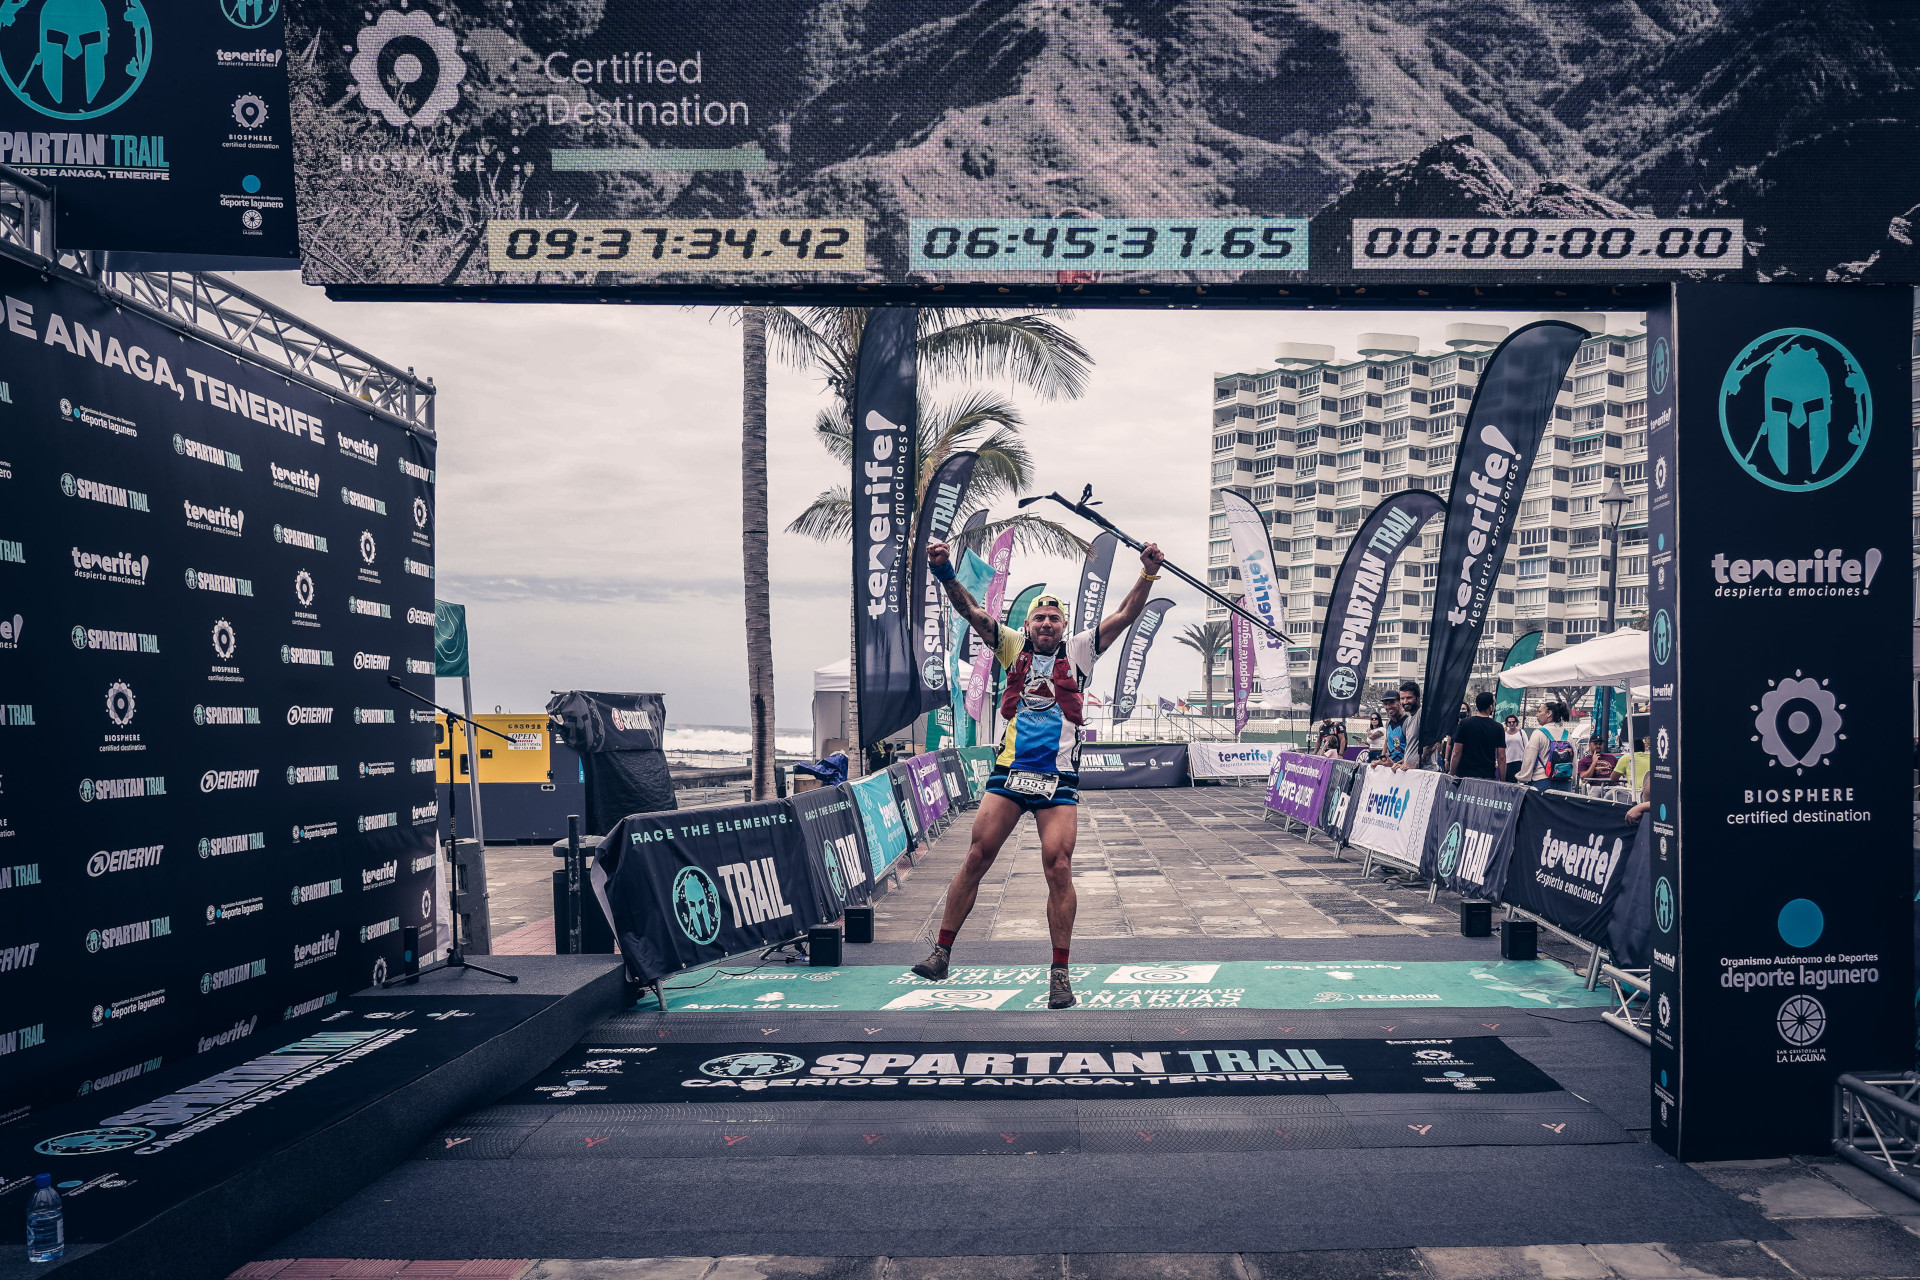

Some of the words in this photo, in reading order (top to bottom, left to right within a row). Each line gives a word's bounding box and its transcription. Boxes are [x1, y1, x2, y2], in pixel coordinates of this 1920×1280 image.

[217, 49, 282, 67] tenerife!
[544, 51, 702, 84] Certified
[546, 95, 750, 126] Destination
[0, 132, 105, 165] PARTAN
[111, 135, 169, 167] TRAIL
[40, 168, 57, 177] DE
[59, 169, 106, 179] ANAGA,
[108, 171, 169, 180] TENERIFE
[341, 155, 487, 173] BIOSPHERE
[220, 199, 248, 208] deporte
[251, 199, 283, 209] lagunero
[506, 228, 851, 259] 09:37:34.42
[922, 228, 1296, 259] 06:45:37.65
[1363, 228, 1732, 259] 00:00:00.00
[45, 313, 184, 401] ANAGA,
[186, 368, 325, 445] TENERIFE
[81, 412, 107, 427] deporte
[109, 424, 137, 437] lagunero
[185, 439, 225, 466] SPARTAN
[225, 451, 243, 472] TRAIL
[338, 432, 378, 465] tenerife!
[271, 462, 319, 497] tenerife!
[405, 461, 429, 481] SPARTAN
[895, 436, 909, 528] emociones
[77, 478, 127, 507] SPARTAN
[128, 490, 150, 512] TRAIL
[350, 491, 375, 512] SPARTAN
[375, 500, 387, 516] TRAIL
[184, 500, 244, 536] tenerife!
[865, 409, 907, 621] tenerife!
[930, 483, 961, 533] TRAIL
[187, 520, 211, 531] despierta
[1447, 424, 1522, 627] tenerife!
[0, 540, 26, 563] TRAIL
[284, 528, 314, 550] SPARTAN
[315, 536, 328, 553] TRAIL
[1468, 553, 1493, 628] despierta
[1492, 463, 1519, 547] emociones
[72, 547, 149, 585] tenerife!
[75, 569, 107, 581] despierta
[109, 576, 141, 585] emociones
[411, 560, 429, 578] SPARTAN
[887, 532, 905, 613] despierta
[1711, 548, 1882, 595] tenerife!
[198, 572, 236, 594] SPARTAN
[237, 579, 253, 597] TRAIL
[1336, 551, 1386, 666] SPARTAN
[1368, 506, 1418, 554] TRAIL
[1715, 586, 1782, 598] despierta
[1788, 587, 1860, 596] emociones
[356, 599, 380, 617] SPARTAN
[380, 603, 391, 619] TRAIL
[88, 629, 137, 651] SPARTAN
[138, 634, 160, 653] TRAIL
[1122, 636, 1148, 696] SPARTAN
[1137, 609, 1161, 636] TRAIL
[290, 648, 320, 666] SPARTAN
[321, 651, 334, 666] TRAIL
[364, 654, 390, 670] ENERVIT
[1240, 649, 1250, 689] deporte
[212, 666, 240, 674] BIOSPHERE
[7, 704, 35, 725] TRAIL
[206, 707, 243, 724] SPARTAN
[244, 707, 260, 724] TRAIL
[300, 707, 333, 724] ENERVIT
[361, 709, 384, 724] SPARTAN
[385, 709, 395, 724] TRAIL
[1105, 754, 1124, 765] TRAIL
[1218, 749, 1273, 762] tenerife!
[218, 769, 259, 790] ENERVIT
[296, 766, 326, 783] SPARTAN
[326, 765, 339, 781] TRAIL
[96, 778, 144, 800] SPARTAN
[146, 777, 167, 795] TRAIL
[1463, 794, 1475, 803] THE
[1744, 787, 1854, 803] BIOSPHERE
[364, 813, 388, 831] SPARTAN
[631, 830, 675, 845] RACE
[678, 824, 710, 838] THE
[716, 813, 794, 833] ELEMENTS.
[1726, 810, 1787, 824] certified
[1792, 809, 1871, 823] destination
[211, 836, 249, 856] SPARTAN
[249, 832, 265, 850] TRAIL
[1456, 828, 1493, 885] TRAIL
[109, 845, 164, 872] ENERVIT
[1541, 829, 1622, 896] tenerife!
[14, 864, 41, 887] TRAIL
[362, 859, 397, 886] tenerife!
[300, 881, 330, 902] SPARTAN
[329, 878, 343, 895] TRAIL
[717, 857, 793, 929] TRAIL
[1565, 881, 1598, 904] emociones
[221, 906, 241, 920] deporte
[241, 902, 263, 915] lagunero
[101, 921, 150, 950] SPARTAN
[151, 916, 172, 938] TRAIL
[367, 919, 390, 940] SPARTAN
[294, 930, 340, 961] tenerife!
[1721, 957, 1772, 968] Organismo
[1774, 955, 1823, 965] Autónomo
[1825, 954, 1836, 962] de
[1838, 952, 1878, 962] Deportes
[212, 963, 250, 990] SPARTAN
[251, 958, 266, 978] TRAIL
[1721, 965, 1795, 992] deporte
[1800, 964, 1879, 990] lagunero
[111, 1004, 137, 1019] deporte
[138, 995, 165, 1011] lagunero
[19, 1023, 45, 1049] TRAIL
[198, 1015, 257, 1054] tenerife!
[809, 1052, 1164, 1076] SPARTAN
[1178, 1048, 1344, 1073] TRAIL
[1777, 1054, 1788, 1063] LA
[1790, 1053, 1826, 1062] LAGUNA
[681, 1077, 899, 1088] CASERIOS
[907, 1077, 966, 1086] DE
[967, 1077, 1134, 1088] ANAGA,
[1140, 1072, 1353, 1086] TENERIFE
